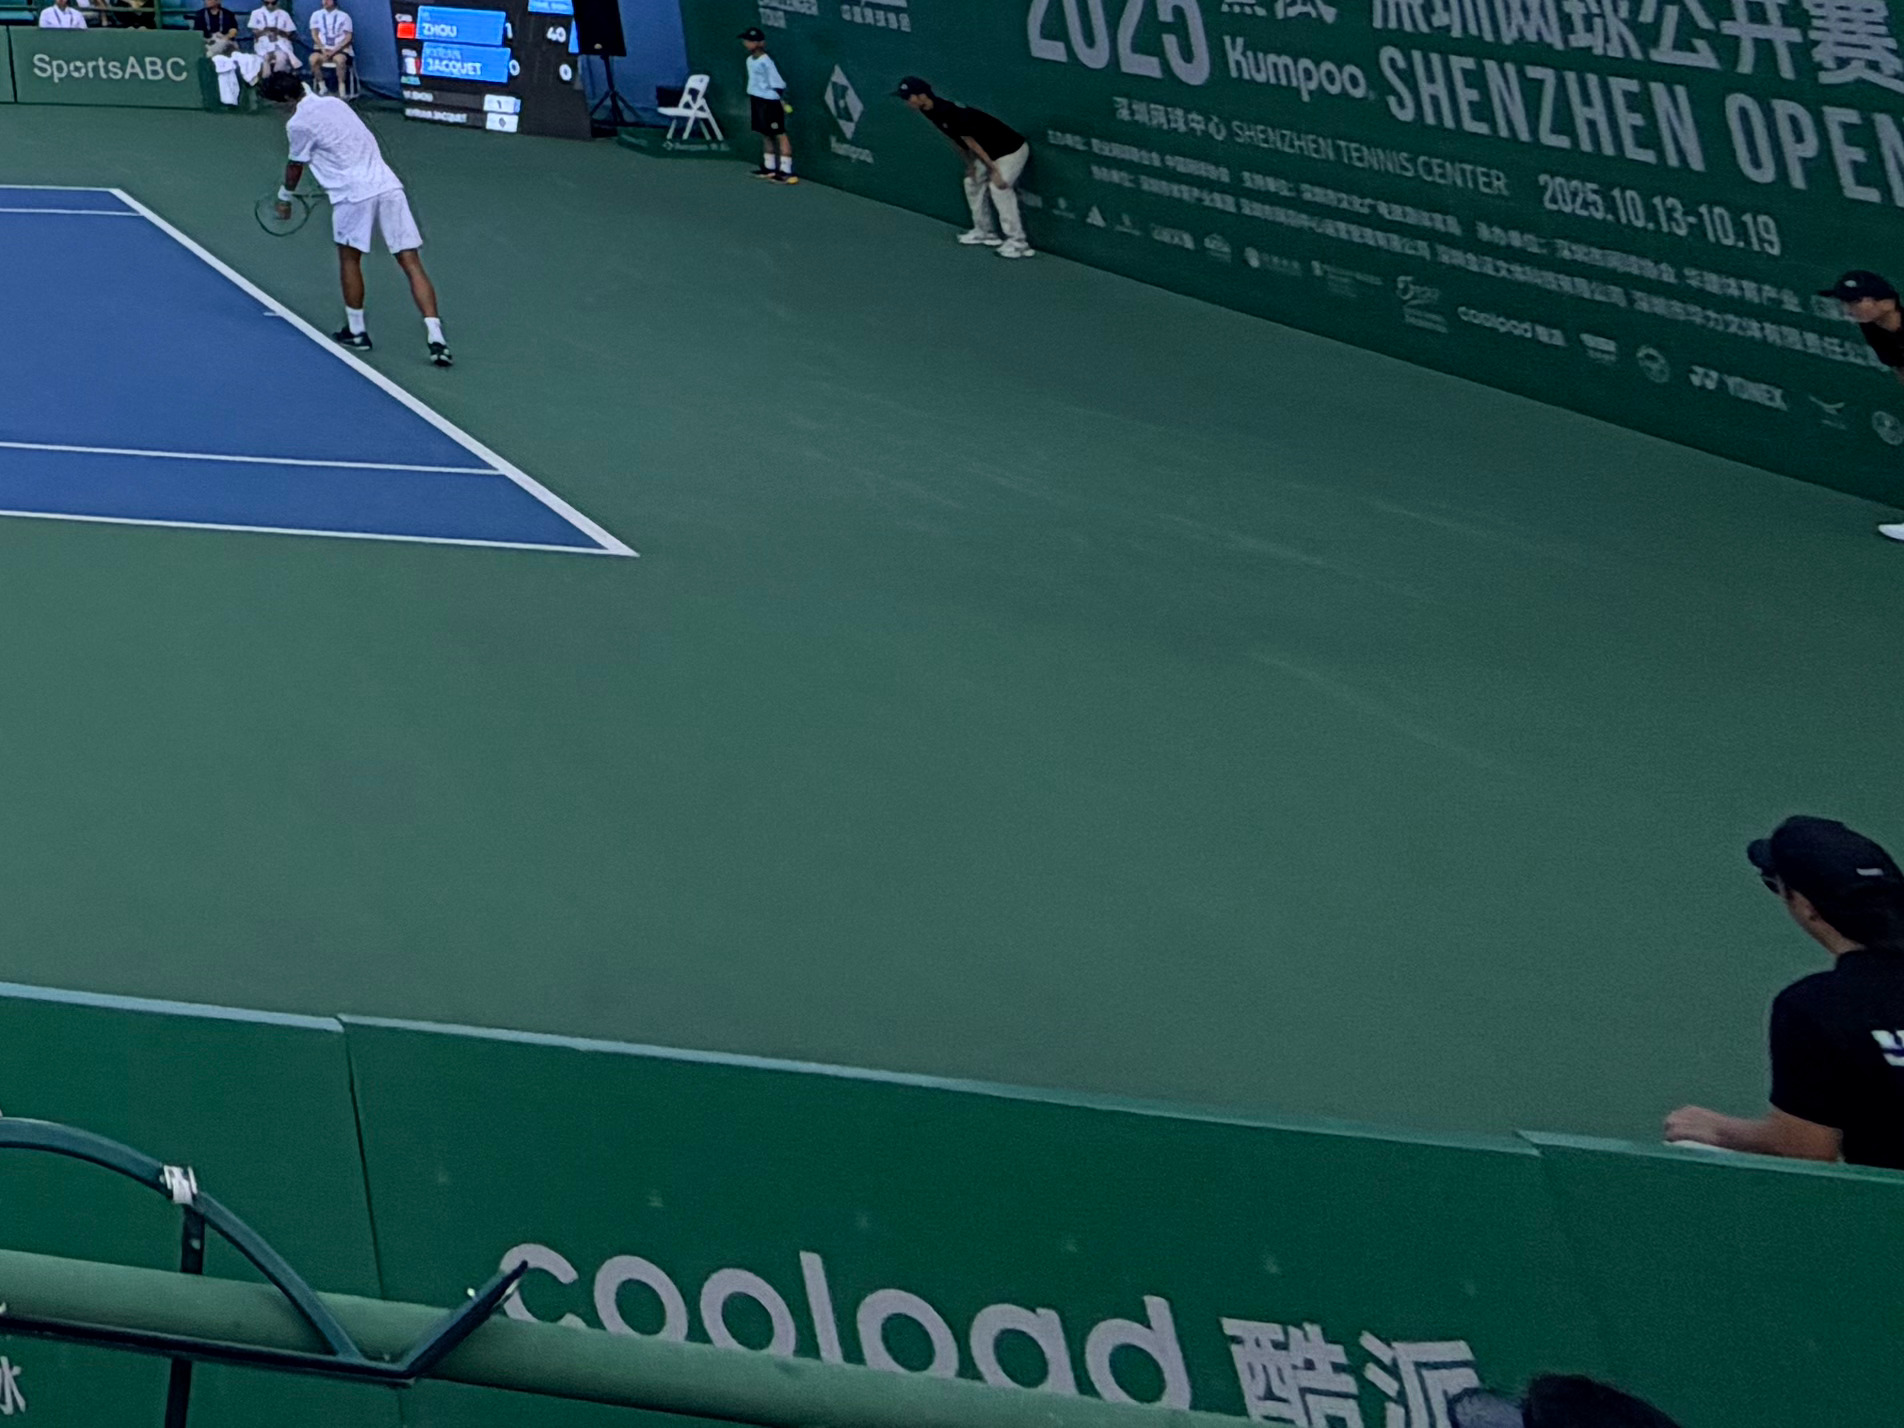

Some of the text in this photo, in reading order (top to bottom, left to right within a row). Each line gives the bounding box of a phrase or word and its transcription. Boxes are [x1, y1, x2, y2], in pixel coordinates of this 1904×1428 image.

[422, 22, 458, 38] ZHOU
[546, 26, 567, 43] 40
[32, 53, 188, 84] SportsABC
[426, 56, 483, 76] JACQUET
[1223, 35, 1368, 103] Kumpoo
[1379, 46, 1707, 172] SHENZHEN
[1231, 120, 1337, 162] SHENZHEN
[1337, 139, 1415, 179] TENNIS
[1415, 155, 1510, 197] CENTER
